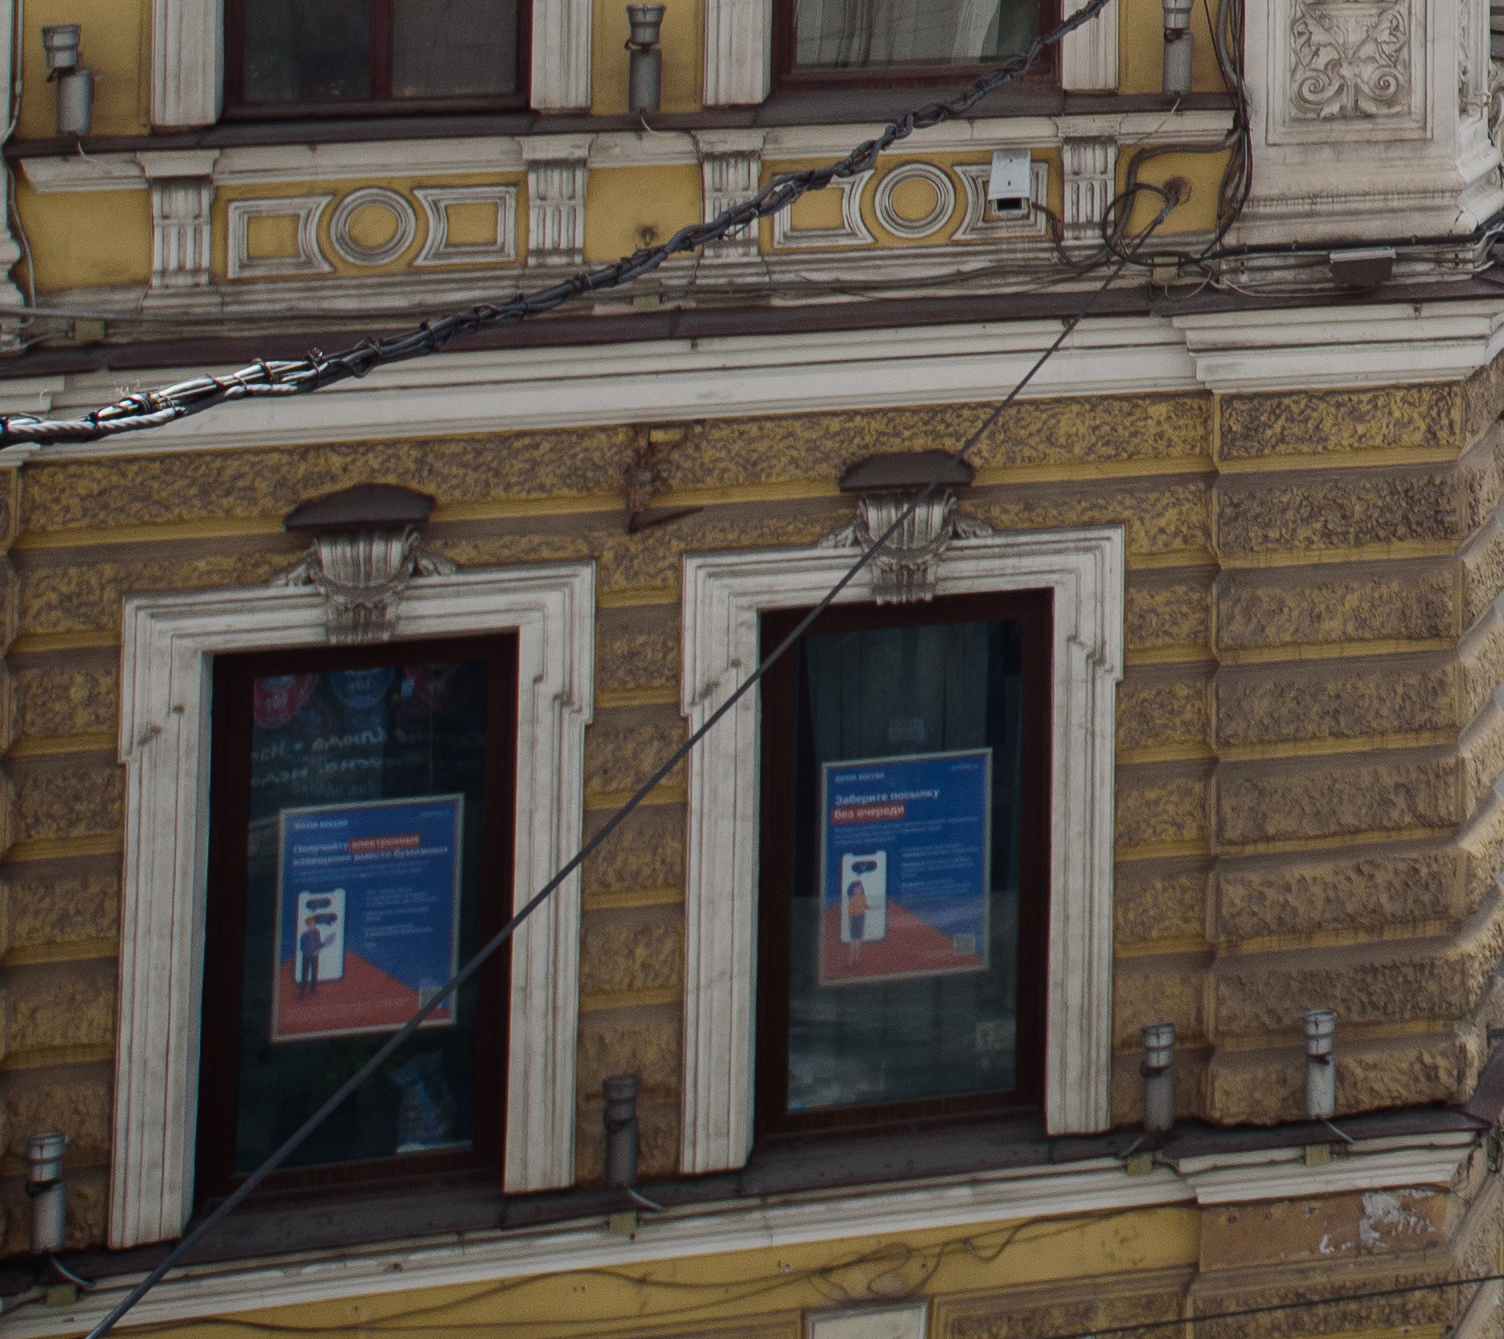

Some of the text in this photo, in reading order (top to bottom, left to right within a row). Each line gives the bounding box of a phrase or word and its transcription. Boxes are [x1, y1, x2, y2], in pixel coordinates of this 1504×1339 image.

[835, 788, 940, 806] Заберите посылку
[834, 804, 905, 820] без очереди
